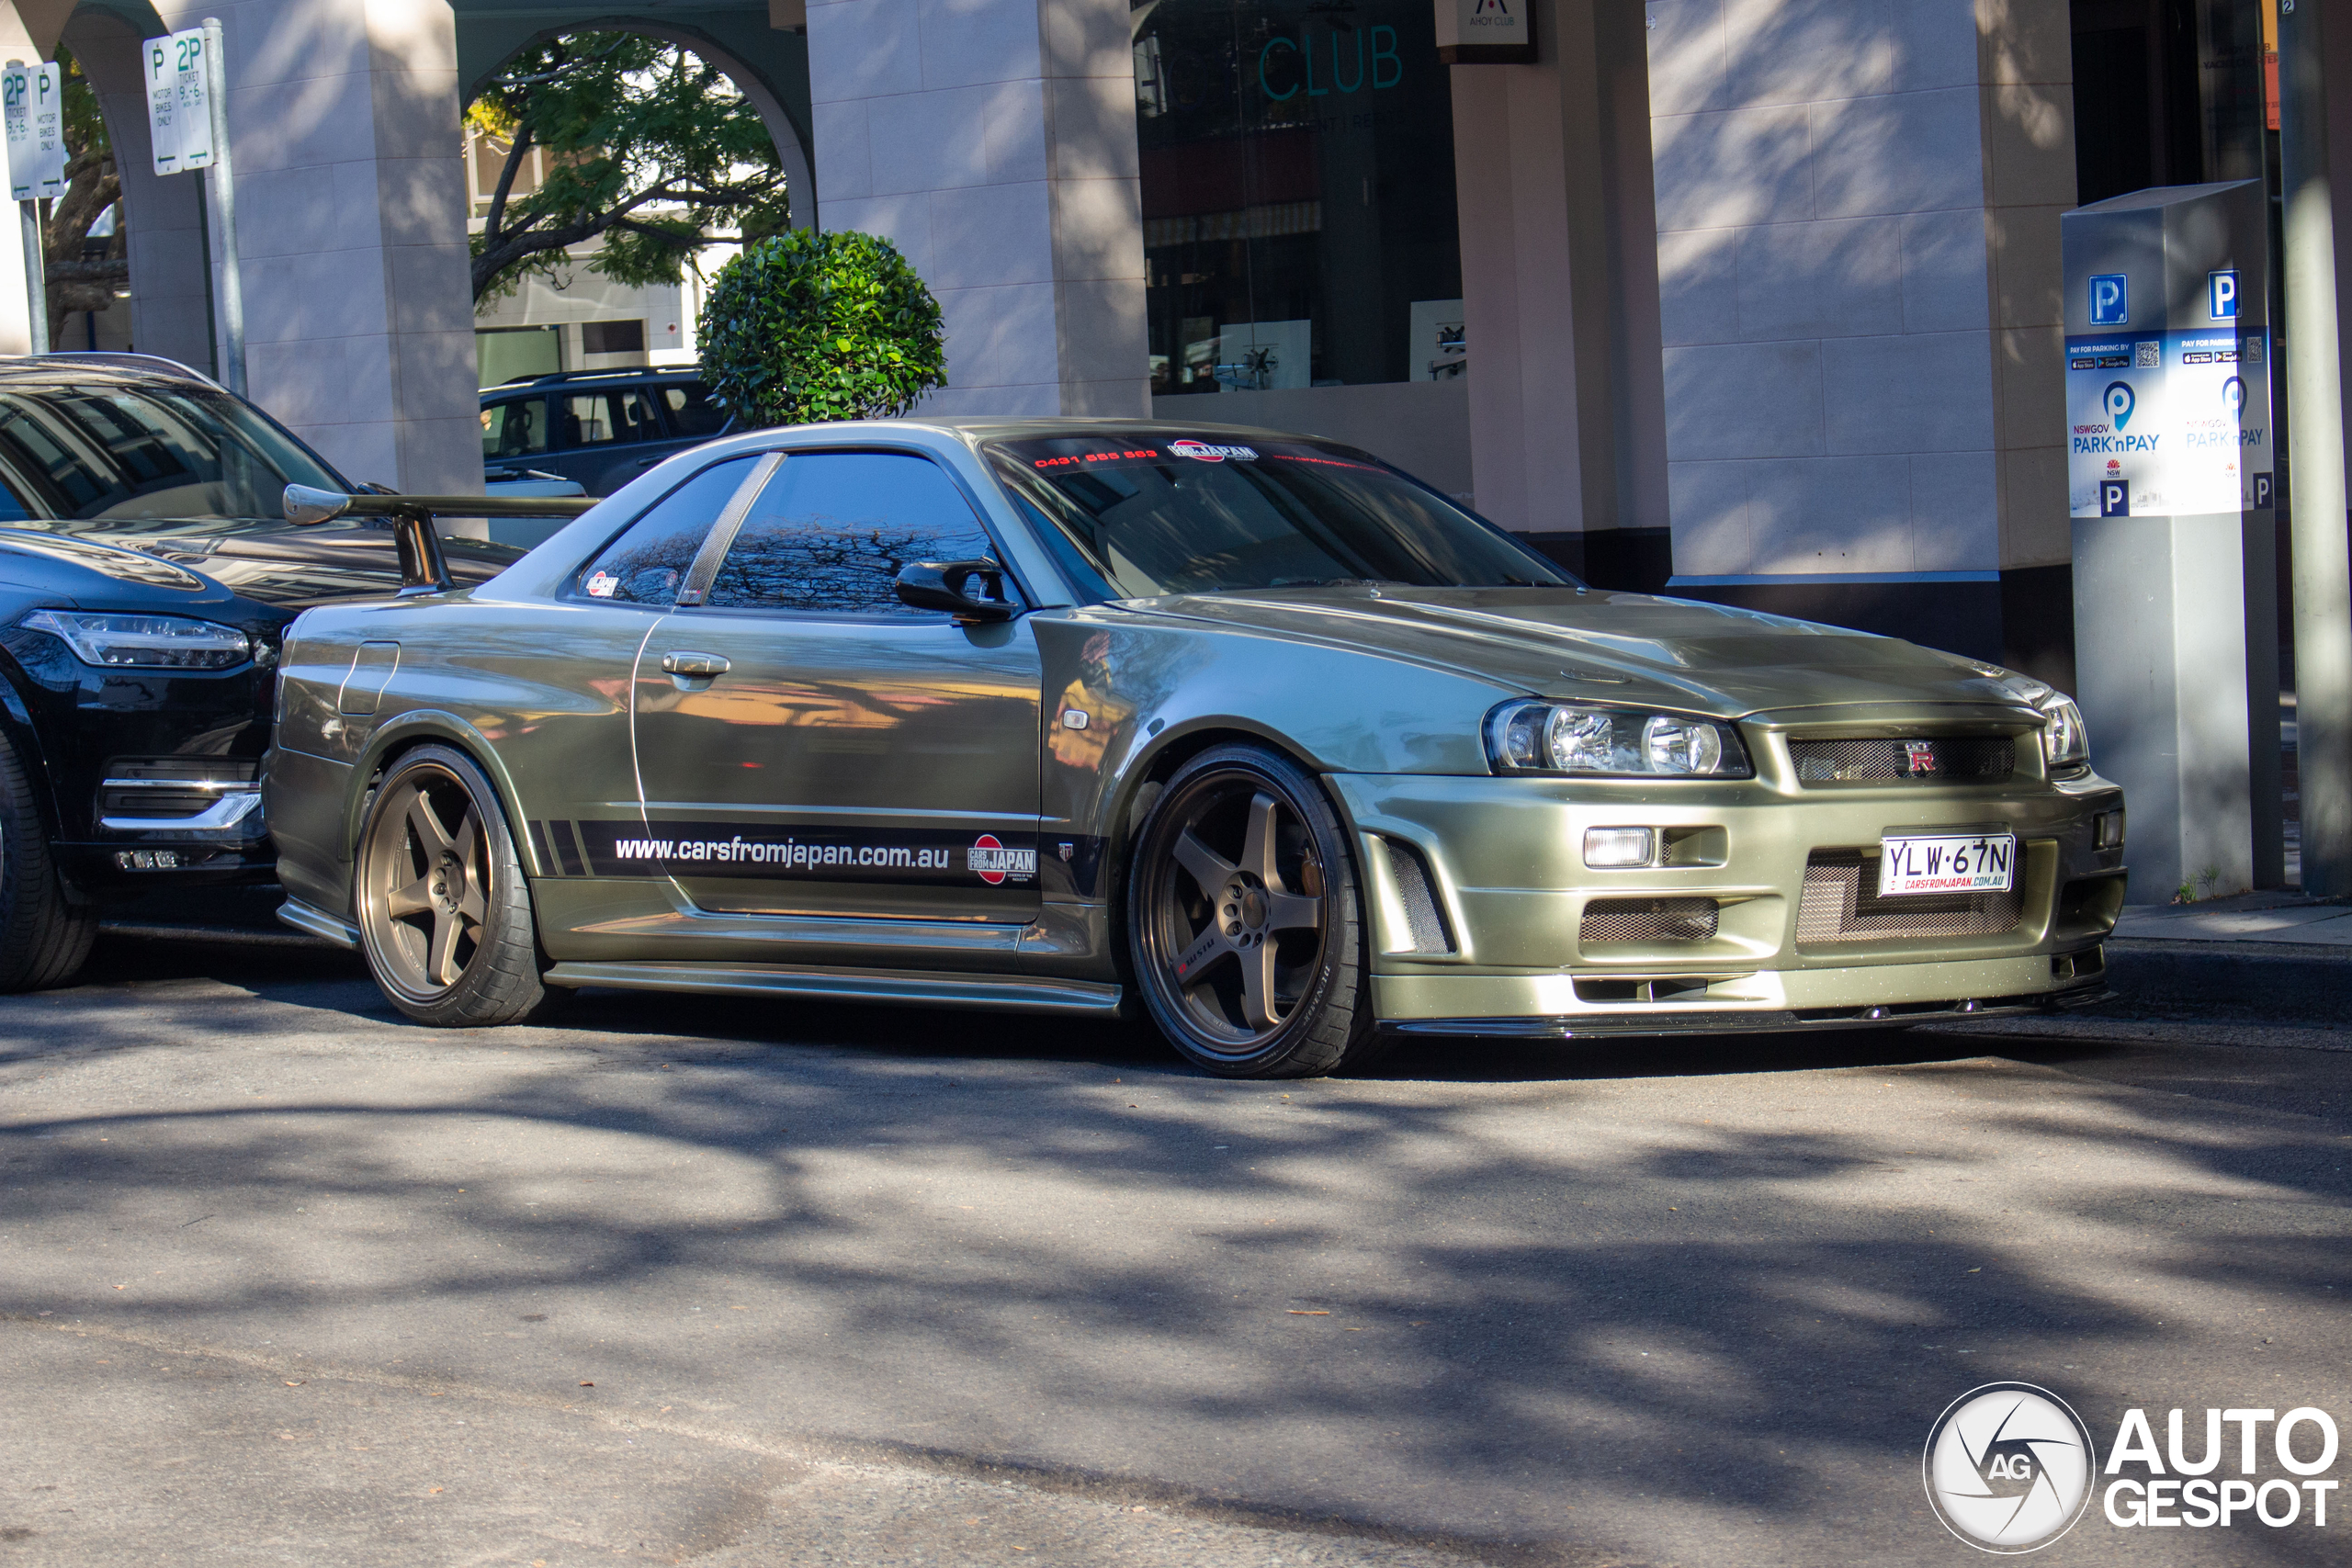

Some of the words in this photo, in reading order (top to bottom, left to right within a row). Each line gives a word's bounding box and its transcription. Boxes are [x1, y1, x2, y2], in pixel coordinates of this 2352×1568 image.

[1470, 17, 1492, 26] AHOY
[1494, 17, 1515, 26] CLUB
[175, 37, 201, 72] 2P
[153, 48, 164, 80] P
[1259, 24, 1403, 101] CLUB
[179, 71, 199, 84] TICKET
[5, 74, 26, 106] 2P
[39, 74, 51, 105] P
[153, 87, 172, 100] MOTOR
[8, 107, 27, 118] TICKET
[155, 101, 172, 114] BIKES
[37, 113, 56, 124] MOTOR
[157, 116, 172, 127] ONLY
[40, 127, 55, 138] BIKES
[40, 141, 55, 152] ONLY
[2096, 280, 2119, 320] P
[2215, 276, 2235, 315] P
[2181, 340, 2195, 348] PAY
[2196, 339, 2209, 347] FOR
[2074, 423, 2109, 434] NSWGOV
[1199, 446, 1255, 457] JAPAN
[2257, 478, 2269, 504] P
[2106, 486, 2122, 512] P
[616, 836, 948, 870] www.carsfromjapan.com.au
[969, 851, 987, 859] CARS
[969, 859, 989, 869] FROM
[989, 852, 1034, 870] JAPAN
[1905, 875, 2005, 890] CARSFROMJAPAN.COM.AU
